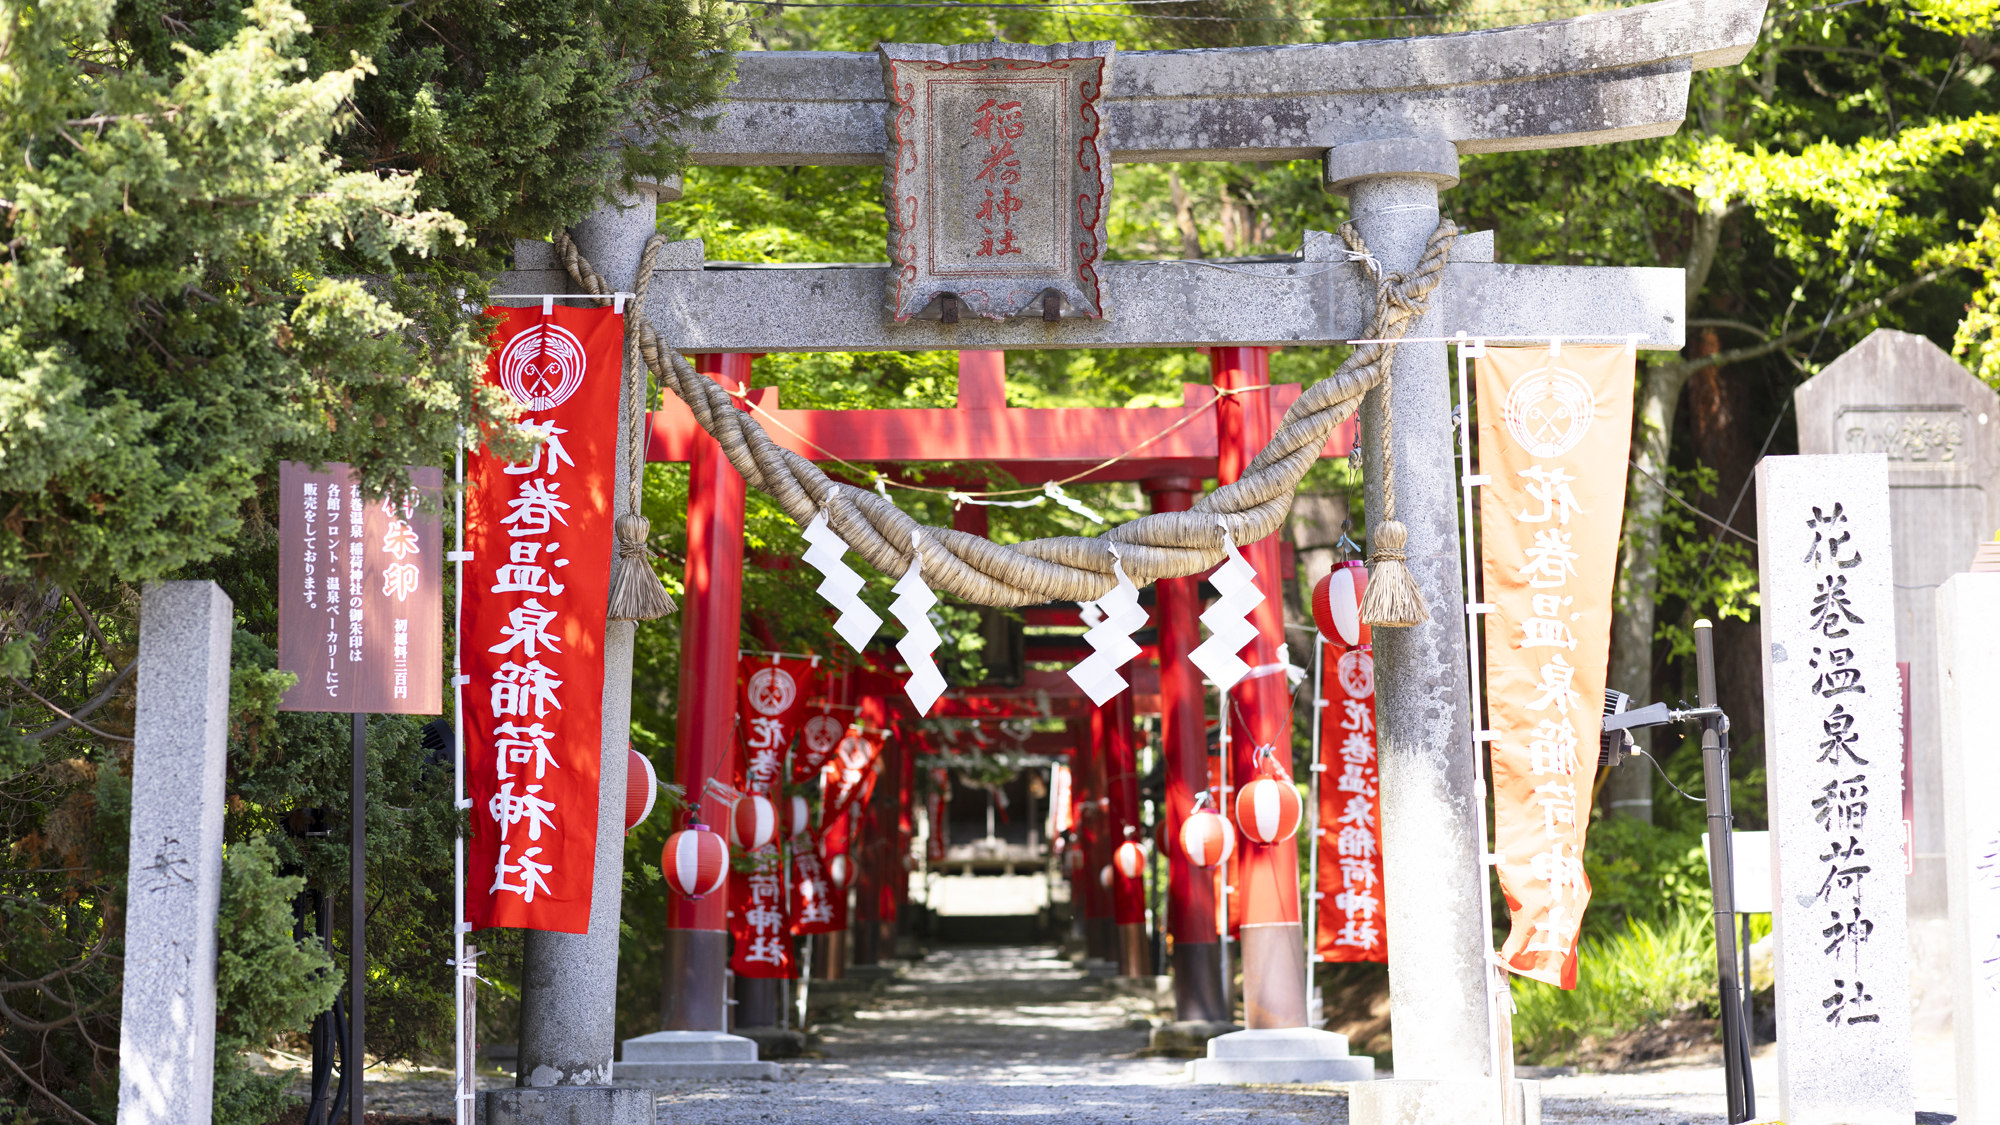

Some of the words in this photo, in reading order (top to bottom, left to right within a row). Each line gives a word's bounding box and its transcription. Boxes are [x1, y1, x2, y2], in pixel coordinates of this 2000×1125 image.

[972, 99, 1025, 257] 稲荷神社
[303, 483, 317, 609] 販売をしております。
[1804, 502, 1880, 1028] 花巻温泉稲荷神社
